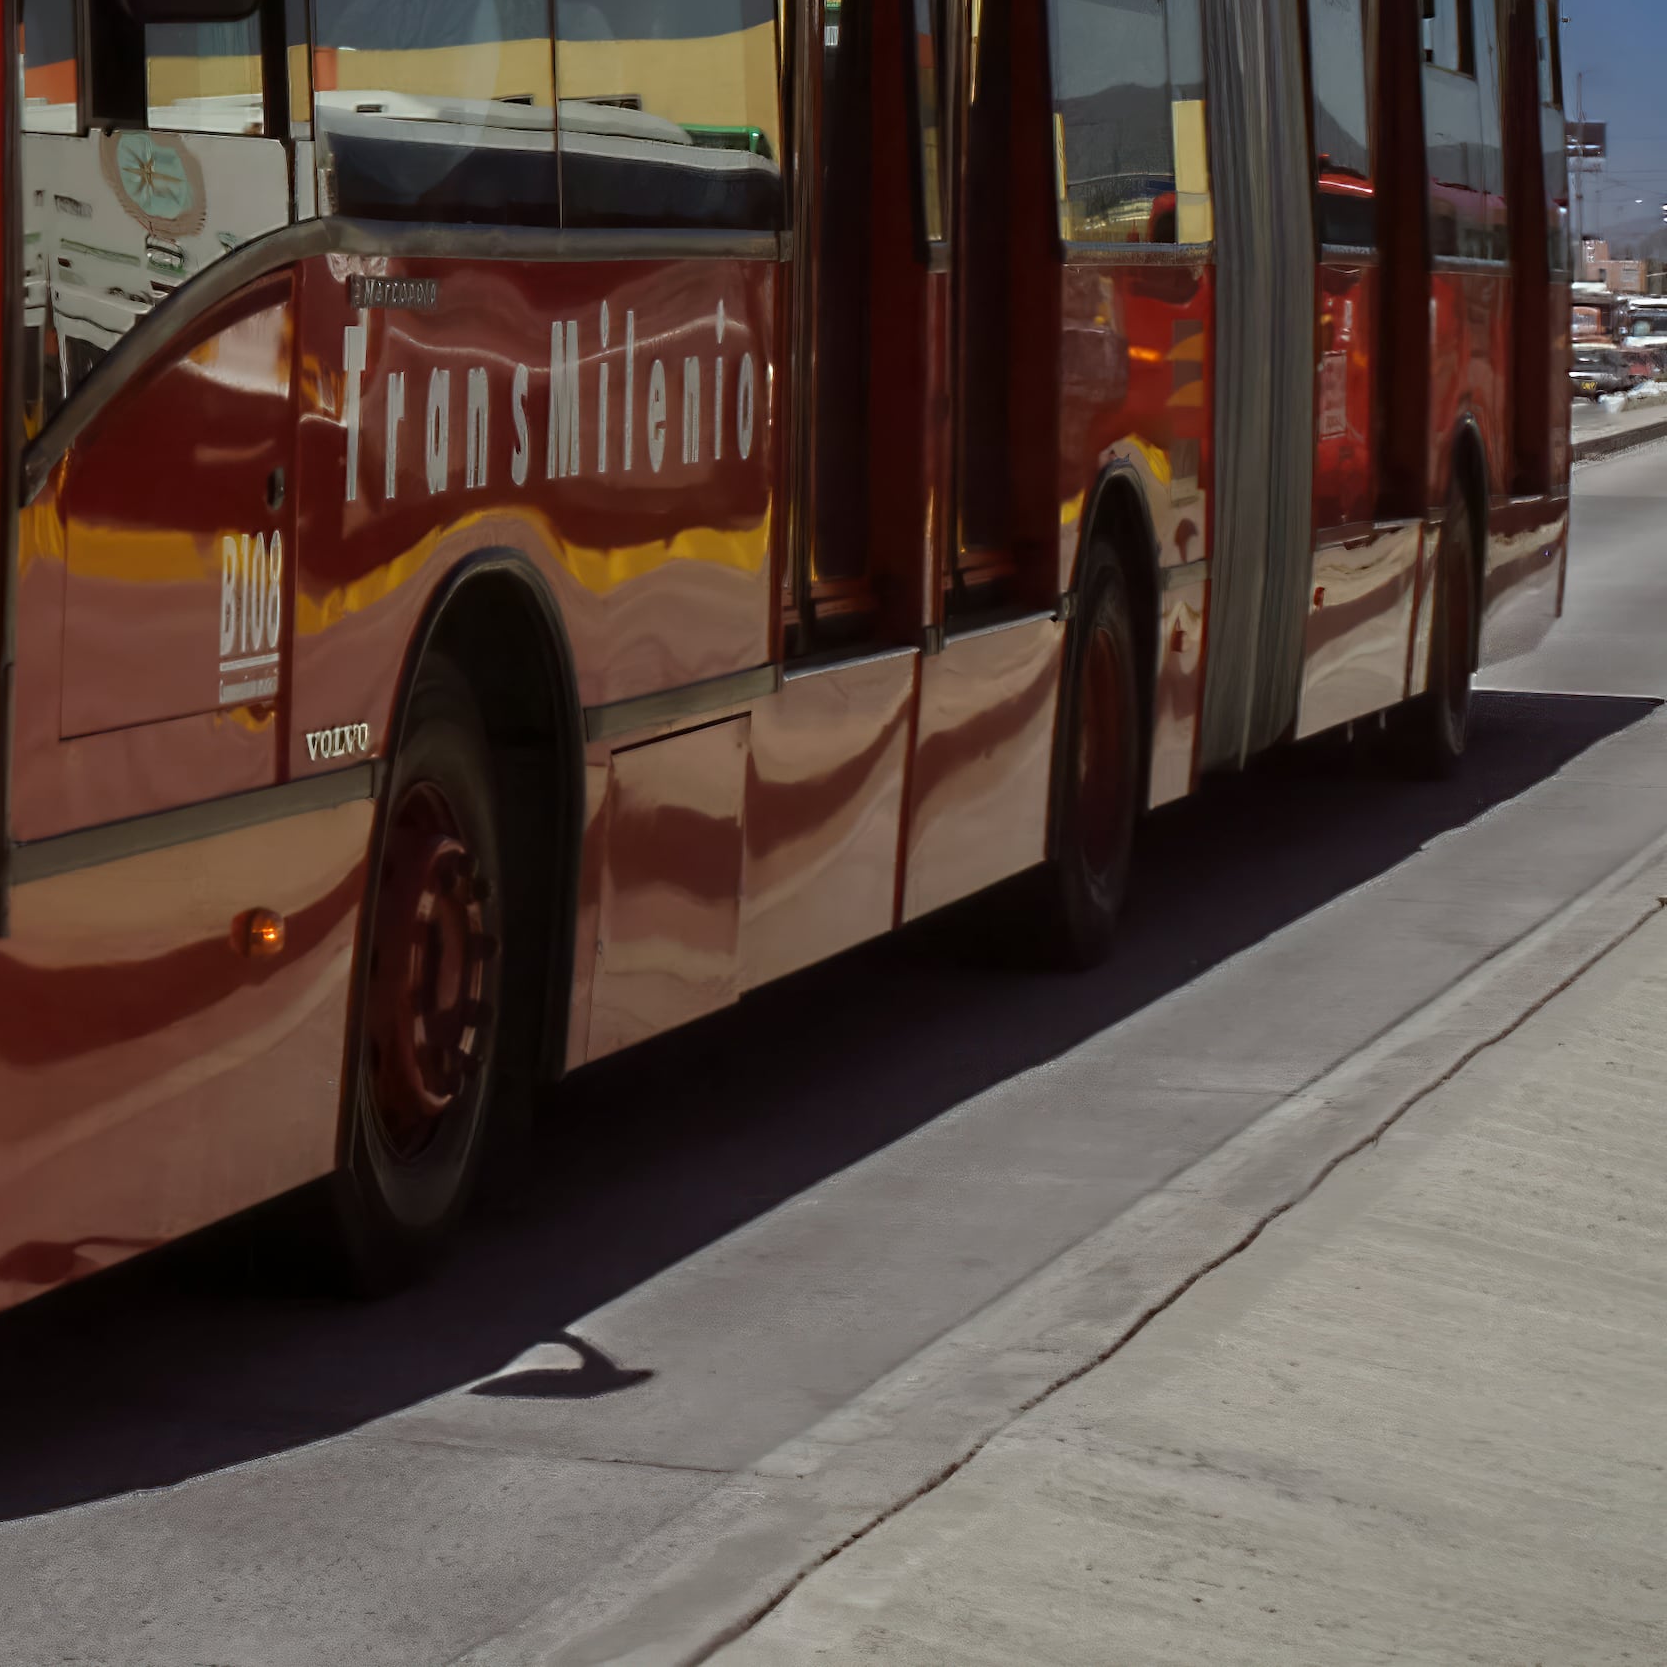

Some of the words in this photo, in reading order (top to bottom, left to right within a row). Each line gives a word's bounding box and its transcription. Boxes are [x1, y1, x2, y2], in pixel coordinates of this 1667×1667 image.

[343, 298, 754, 502] TransMilenio
[220, 529, 283, 656] B108
[305, 722, 369, 762] VOLVO
